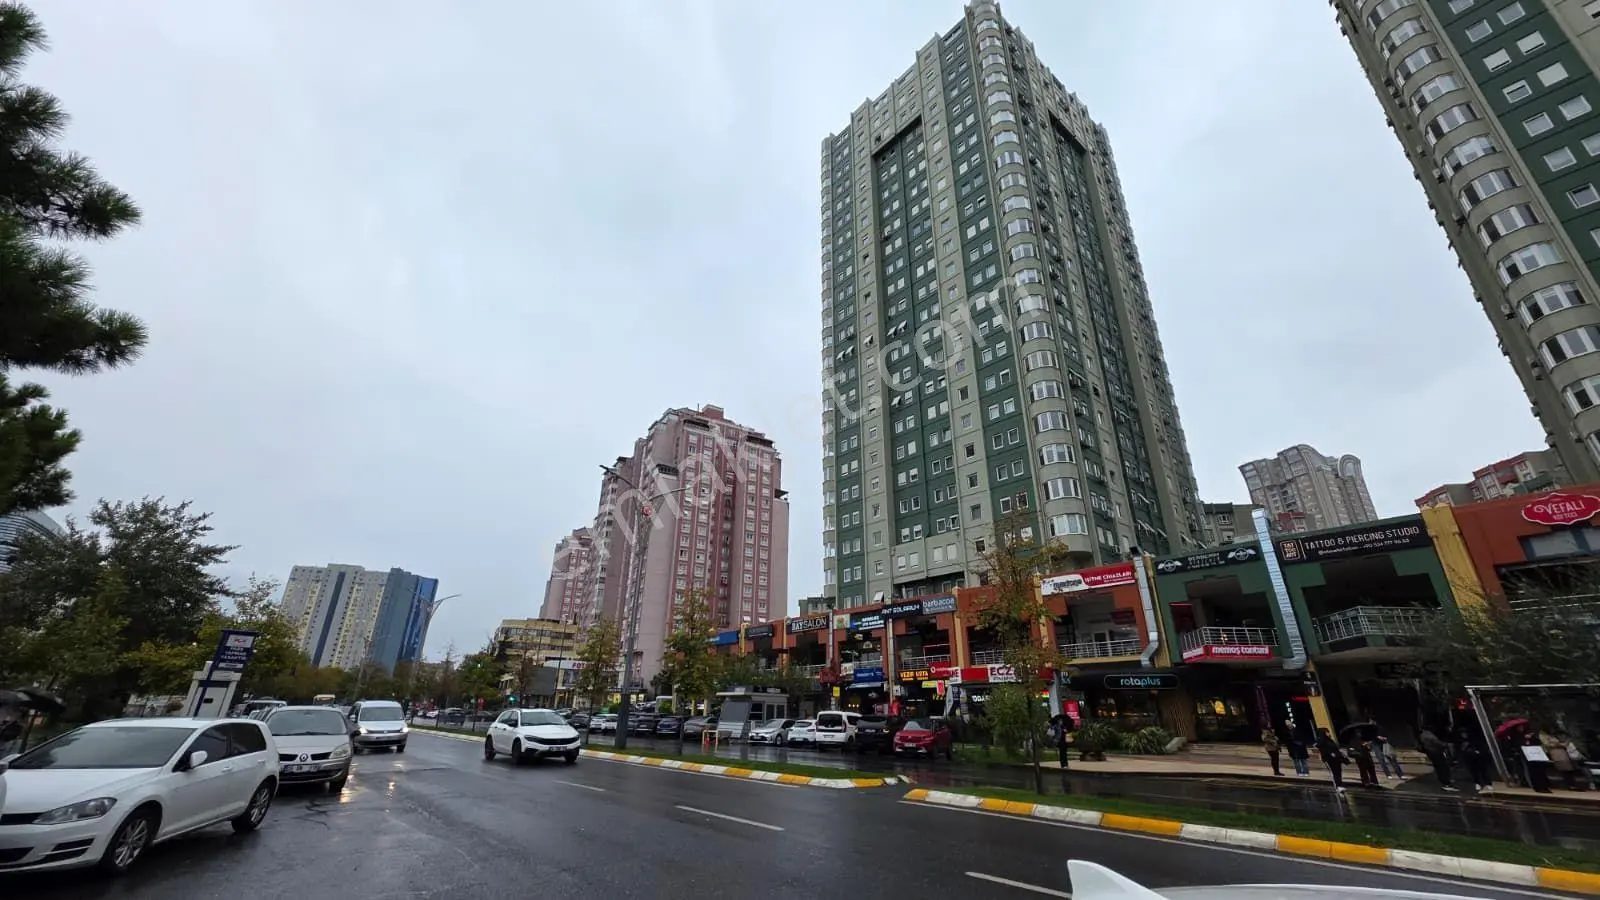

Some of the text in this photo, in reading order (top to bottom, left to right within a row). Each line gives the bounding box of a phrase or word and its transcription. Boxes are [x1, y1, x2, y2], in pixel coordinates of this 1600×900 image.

[1304, 526, 1420, 550] TATTOO & PIERCING STUDIO
[1120, 677, 1161, 688] rotaplus
